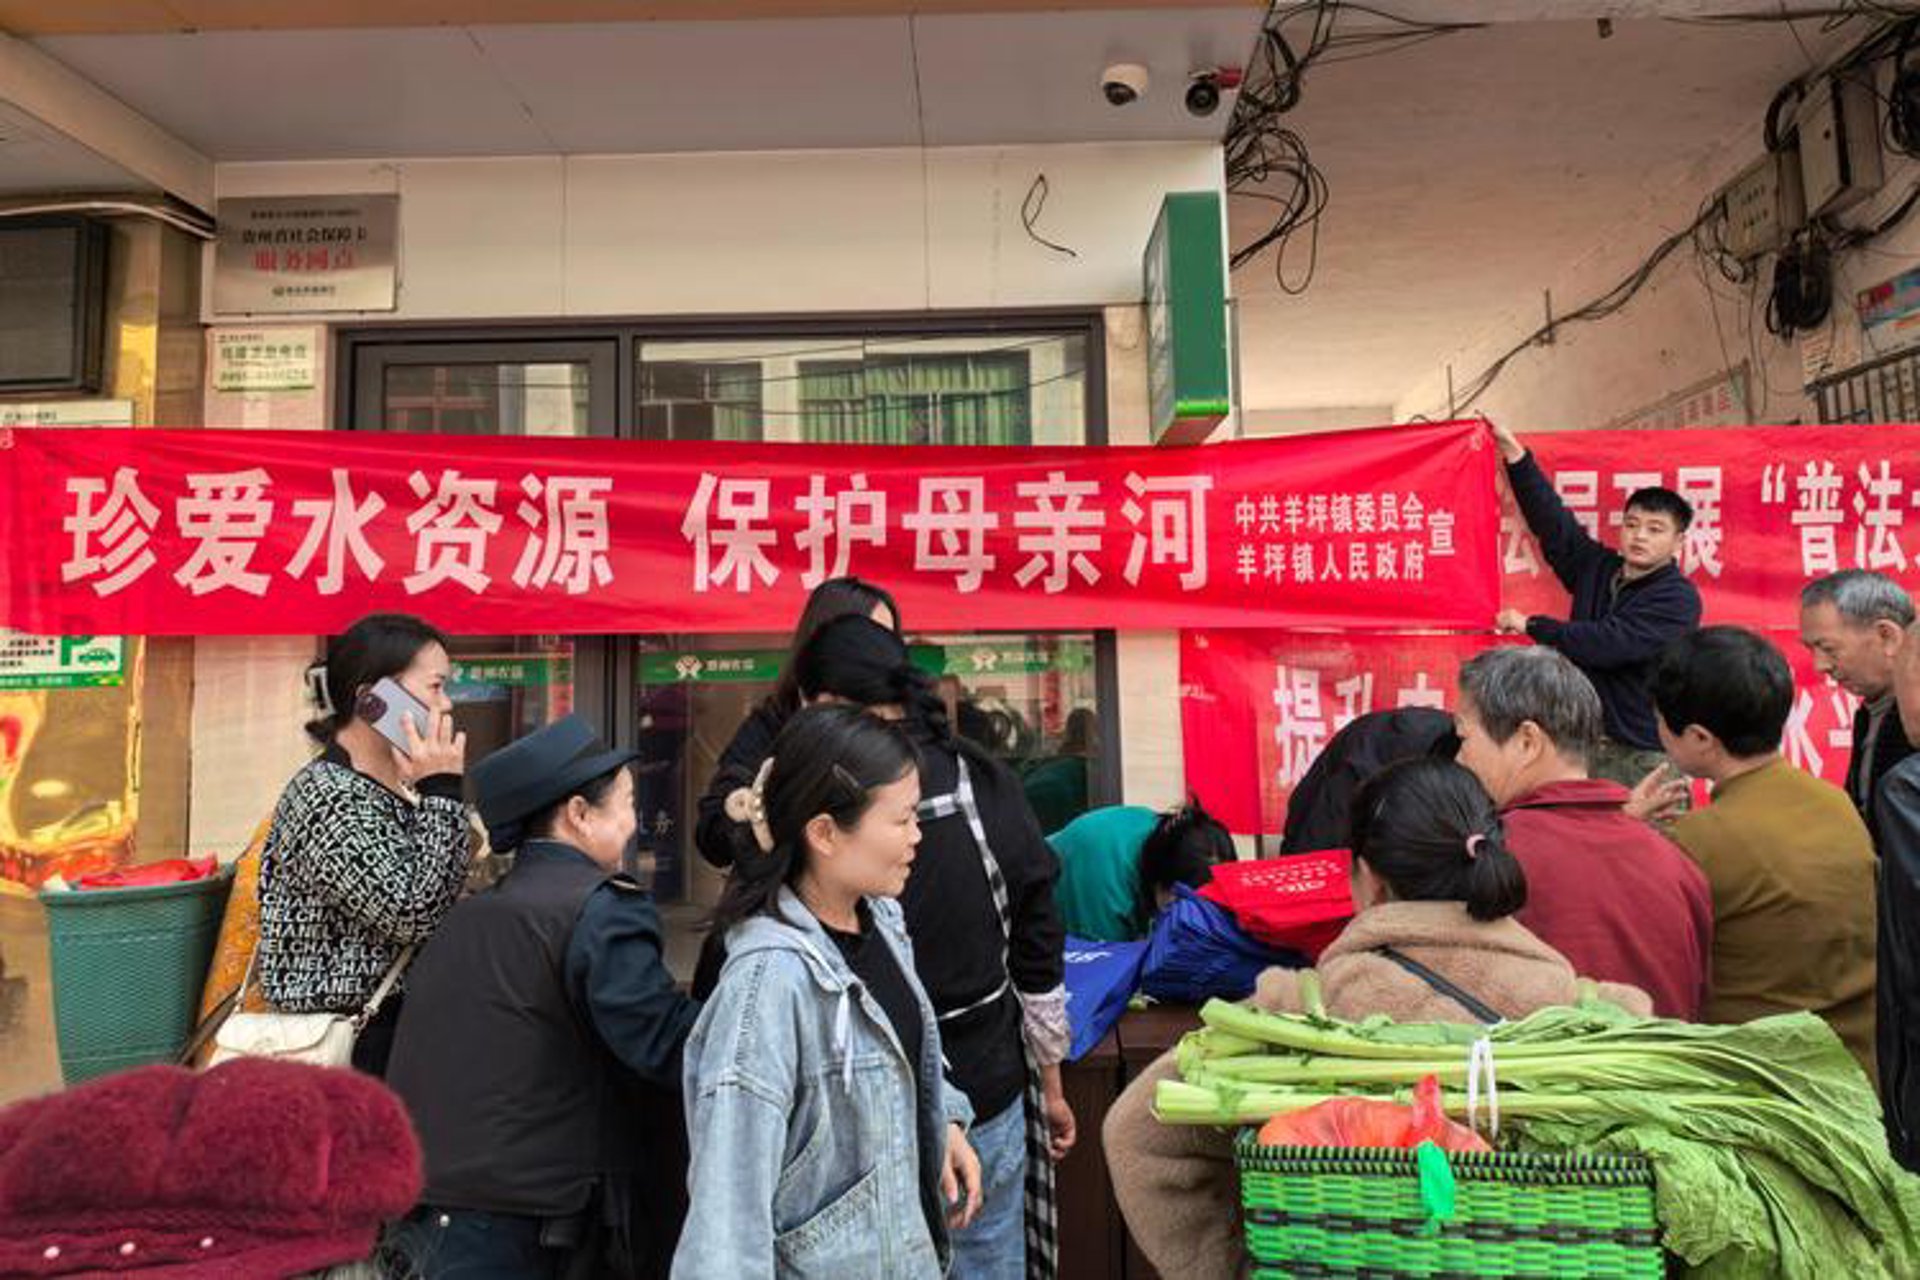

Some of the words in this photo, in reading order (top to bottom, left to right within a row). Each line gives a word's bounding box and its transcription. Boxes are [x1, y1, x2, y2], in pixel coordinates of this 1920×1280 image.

[61, 466, 614, 598] 珍爱水资源
[681, 471, 1213, 593] 保护母亲河
[1235, 491, 1425, 535] 中共羊坪镇委员会
[1427, 508, 1456, 556] 宣
[1236, 540, 1425, 585] 羊坪镇人民政府
